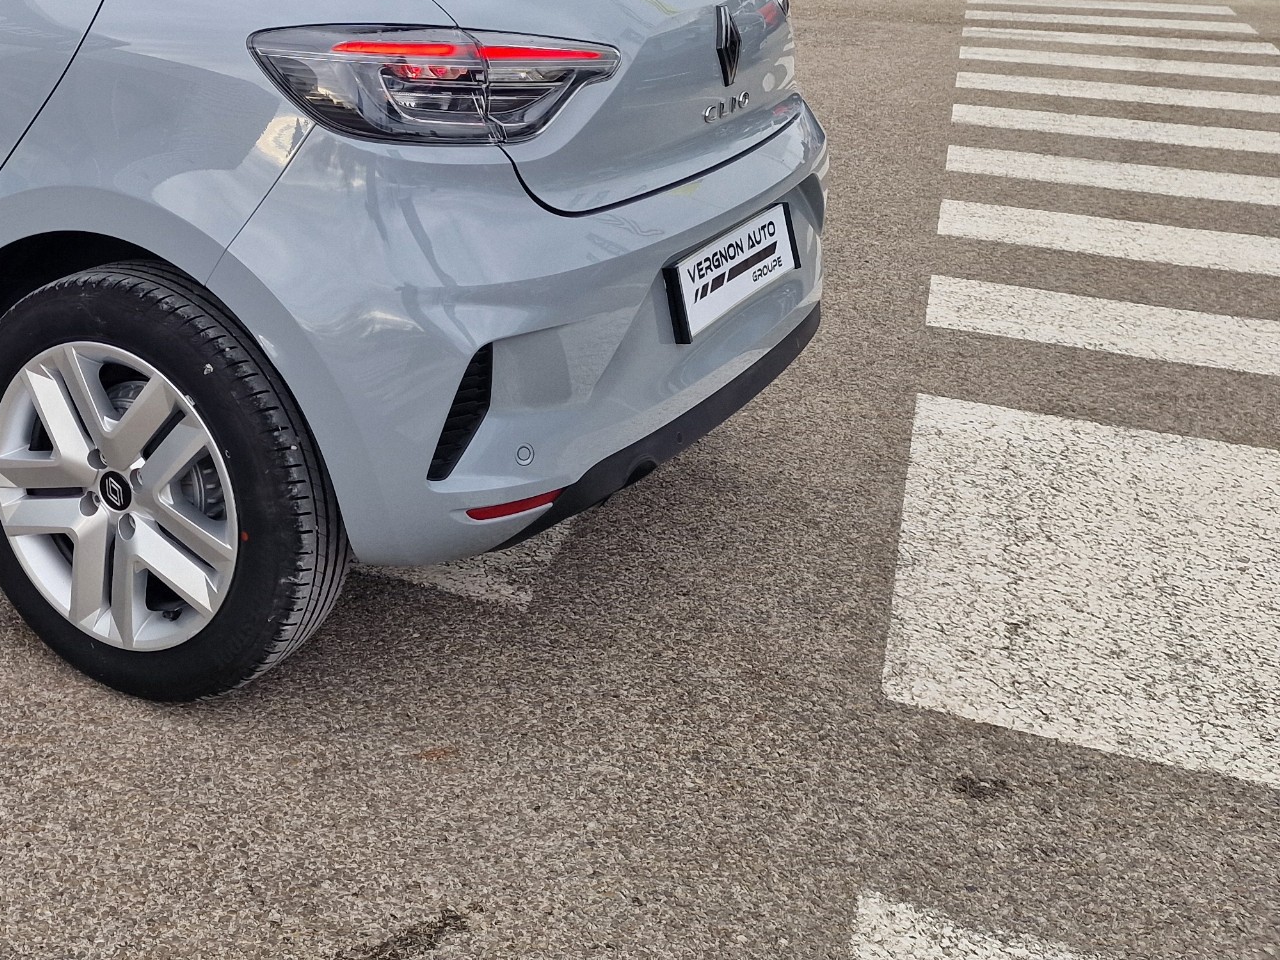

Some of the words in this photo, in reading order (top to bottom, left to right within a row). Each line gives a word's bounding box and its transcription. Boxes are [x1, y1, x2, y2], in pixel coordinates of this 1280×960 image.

[703, 90, 750, 124] CLIO
[687, 237, 745, 284] VERGNON
[747, 220, 776, 251] AUTO
[752, 255, 783, 283] GROUPE
